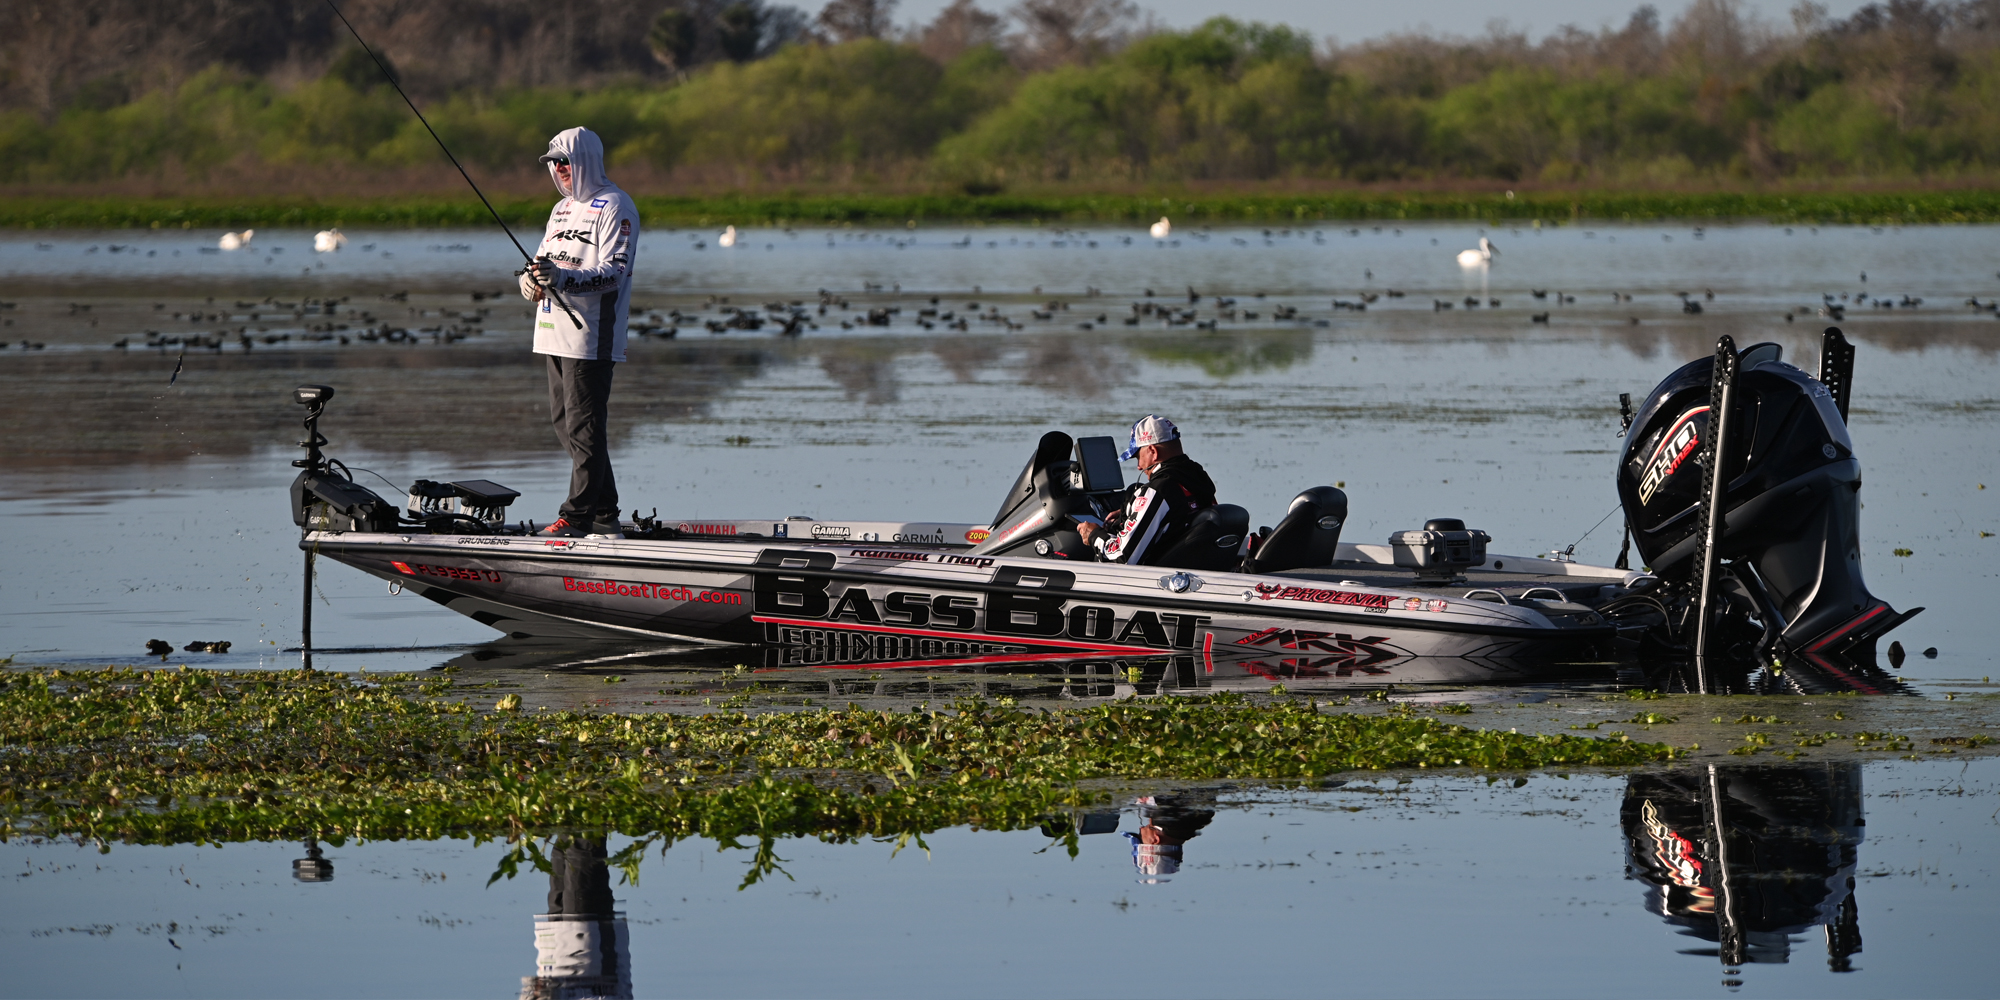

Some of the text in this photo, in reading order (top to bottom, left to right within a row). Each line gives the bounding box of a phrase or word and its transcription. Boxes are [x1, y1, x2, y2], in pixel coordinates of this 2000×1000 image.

[1639, 421, 1697, 506] SHO
[310, 516, 329, 524] GARN
[691, 524, 737, 535] YAMAHA
[811, 524, 851, 536] GAMMA
[892, 533, 944, 543] GARMIN
[563, 576, 742, 605] BassBoatTech.com
[1276, 586, 1400, 609] PHOENIX
[1428, 600, 1447, 608] MLF
